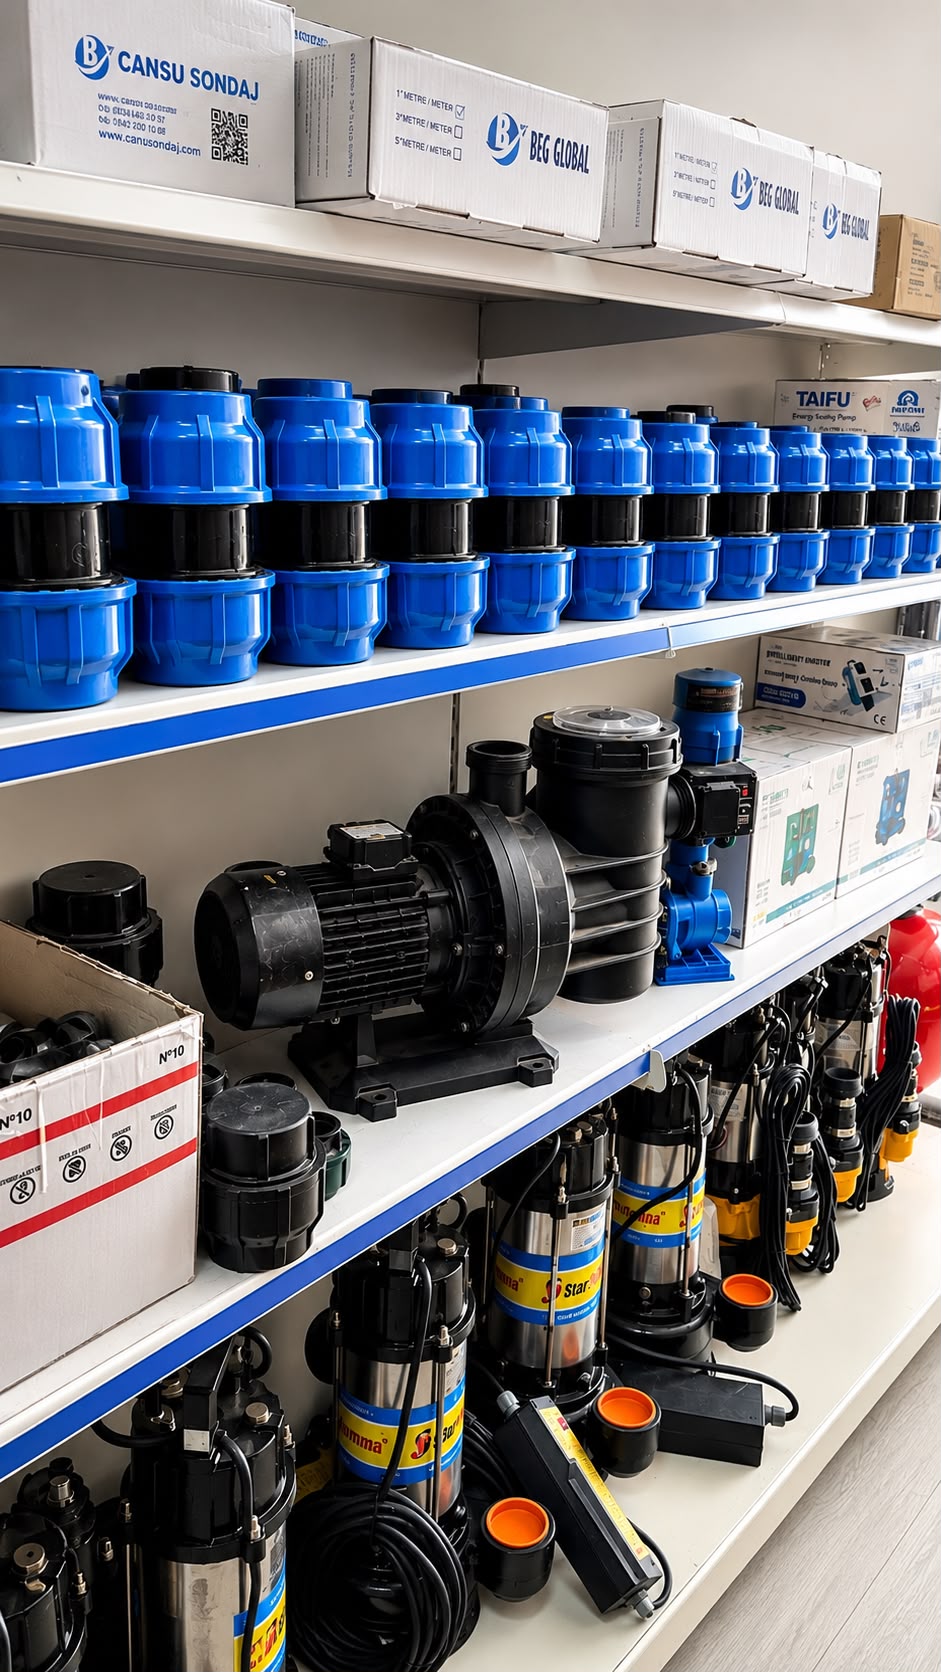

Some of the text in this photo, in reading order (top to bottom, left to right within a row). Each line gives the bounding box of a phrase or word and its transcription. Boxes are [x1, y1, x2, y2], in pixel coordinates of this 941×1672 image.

[117, 50, 185, 84] CANSU
[190, 67, 260, 101] SONDAJ
[431, 98, 454, 112] METER
[430, 121, 453, 135] METER
[98, 129, 201, 156] www.canusondaj.com
[429, 145, 452, 157] METER
[529, 129, 550, 165] BEG
[553, 138, 590, 175] GLOBAL
[758, 181, 773, 208] BEG
[774, 185, 799, 215] GLOBAL
[851, 215, 870, 240] GLOBAL
[796, 390, 851, 408] TAIFU
